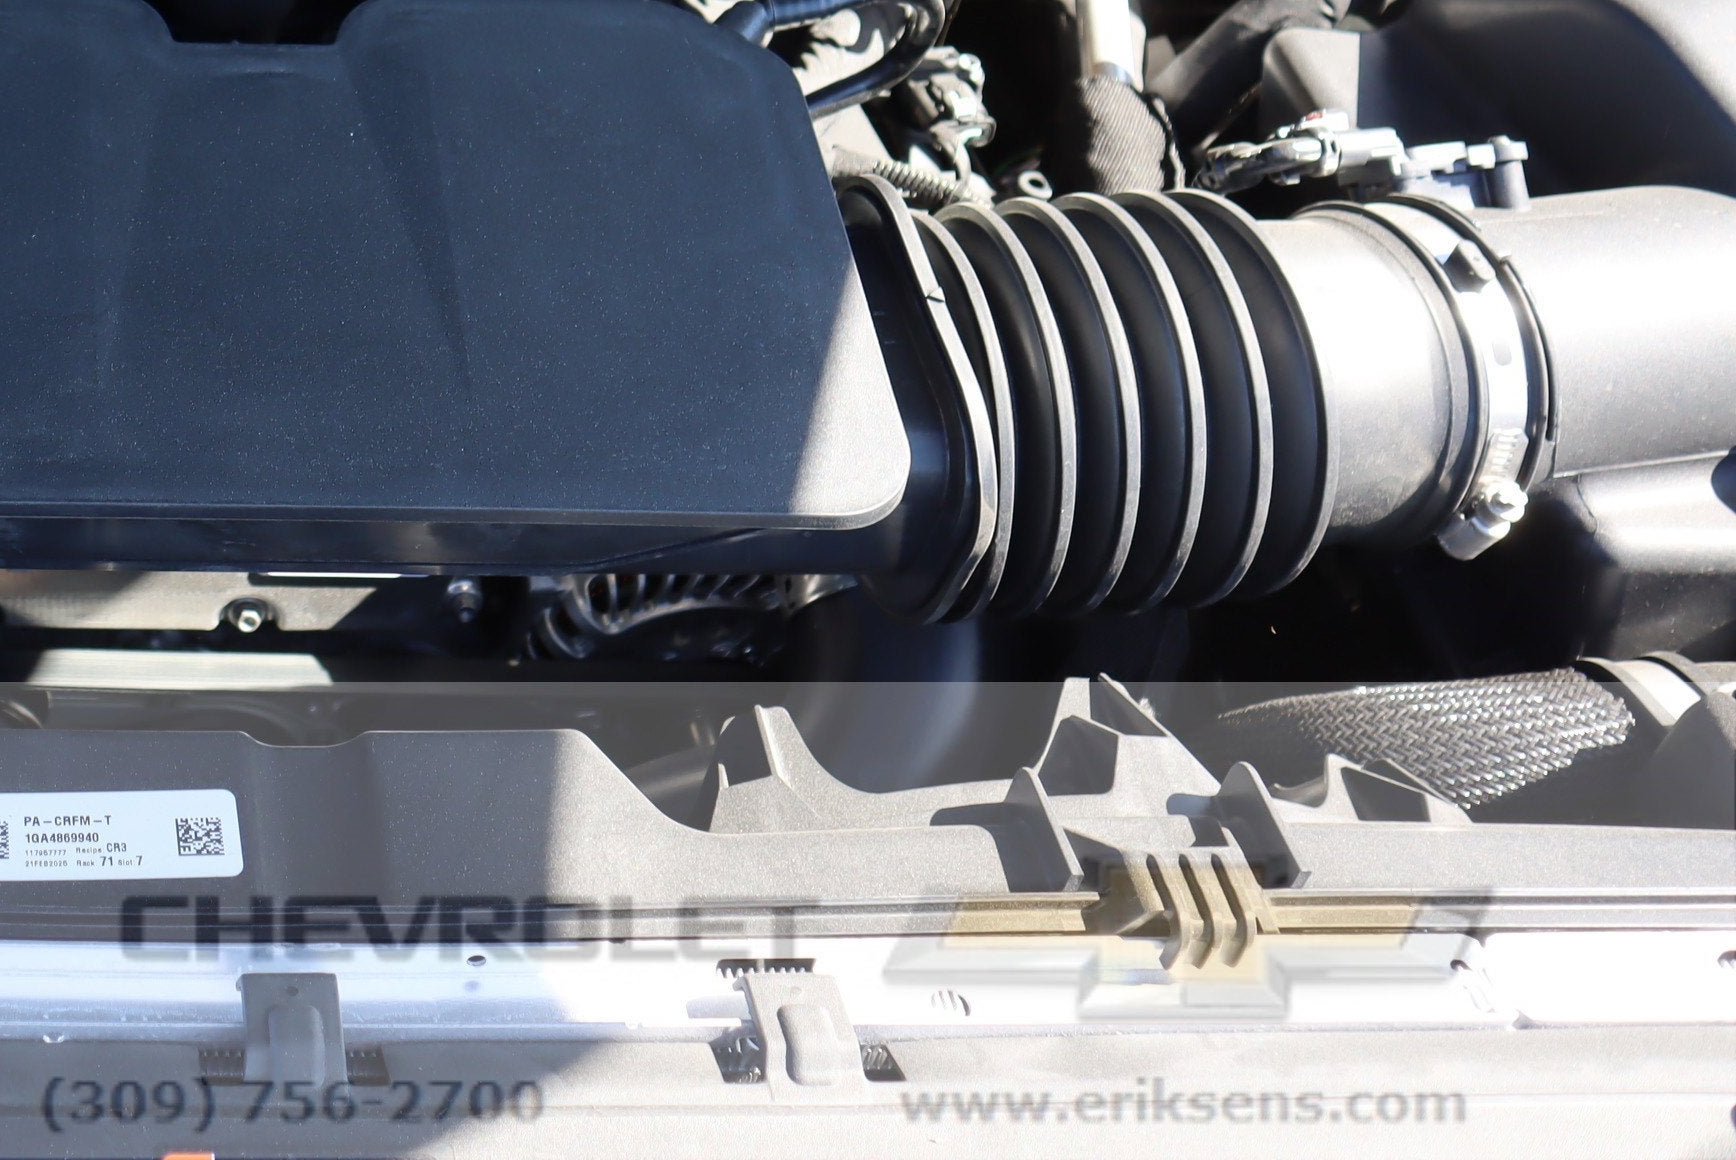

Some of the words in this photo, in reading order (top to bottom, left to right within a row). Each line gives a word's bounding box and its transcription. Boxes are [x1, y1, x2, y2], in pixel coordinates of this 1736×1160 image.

[106, 843, 128, 853] CR3
[100, 856, 114, 867] 71
[136, 856, 144, 867] 7
